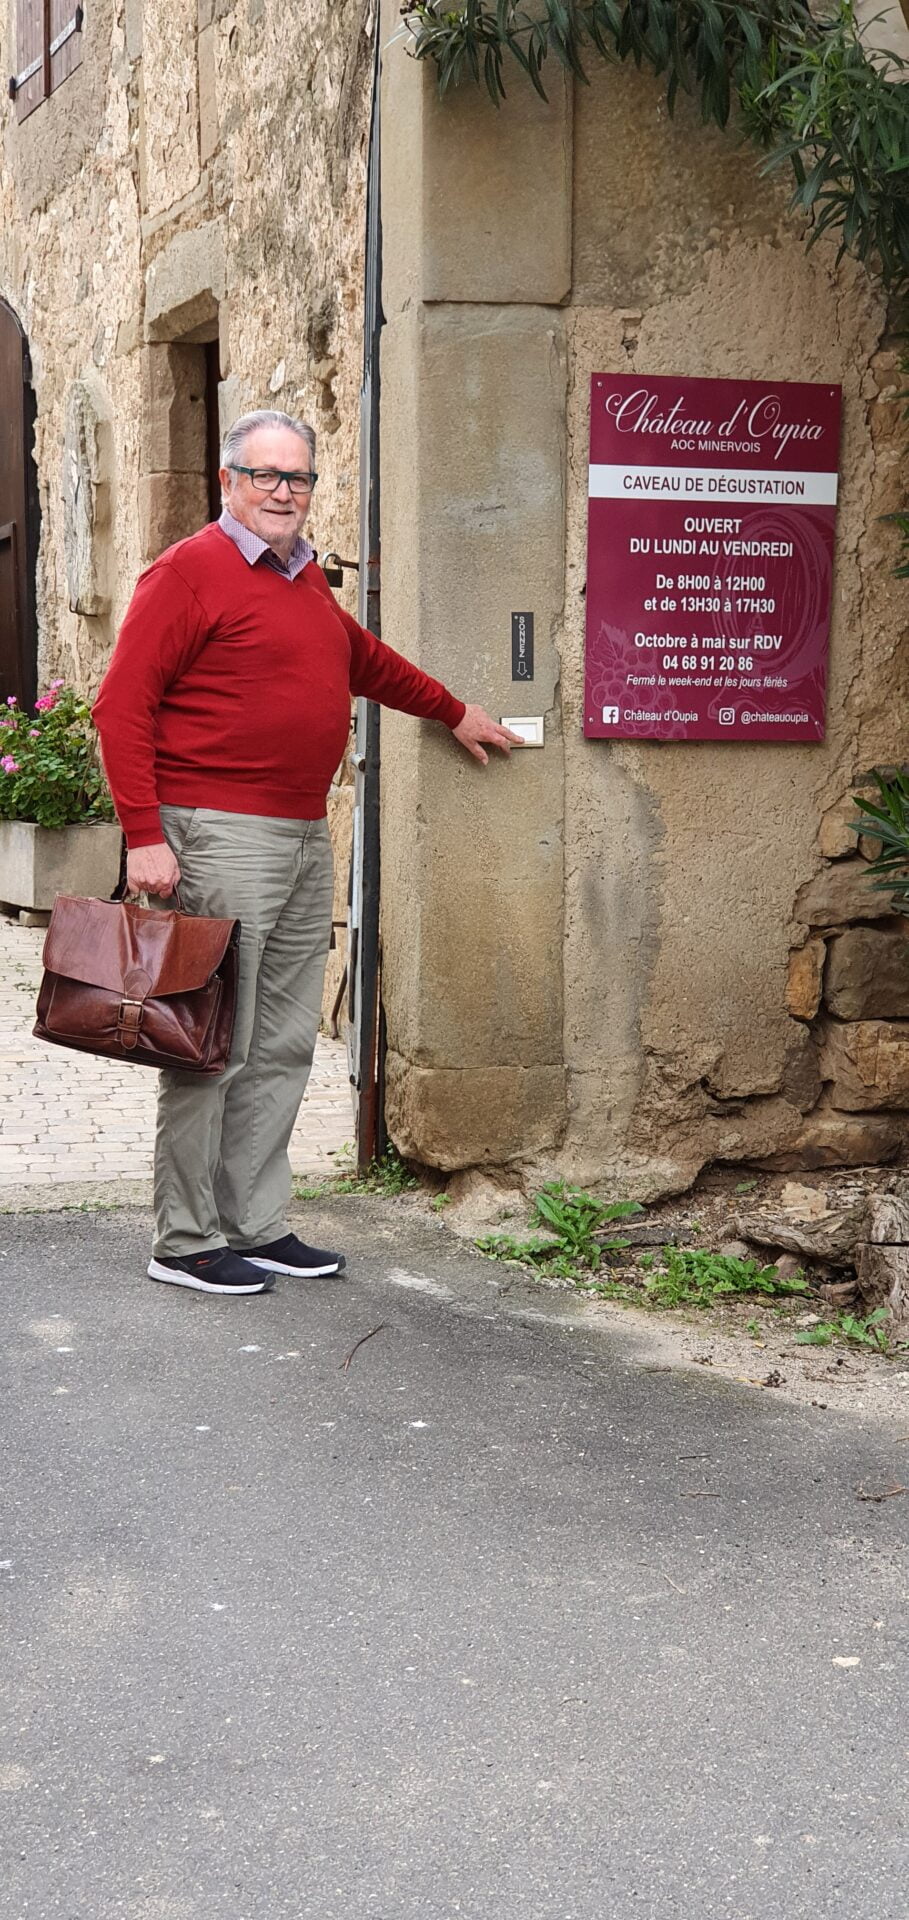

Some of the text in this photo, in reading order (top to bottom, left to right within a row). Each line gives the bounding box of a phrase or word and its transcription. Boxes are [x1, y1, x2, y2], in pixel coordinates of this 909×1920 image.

[605, 389, 825, 460] Château d'Oupia
[671, 439, 761, 453] AOC MINERVOIS
[623, 475, 805, 495] CAVEAU DE DÉGUSTATION
[684, 518, 742, 534] OUVERT
[630, 538, 793, 557] DU LUNDI AU VENDREDI
[656, 574, 765, 591] De 8H00 à 12H00
[644, 597, 775, 613] et de 13H30 à 17H30
[635, 633, 782, 650] Octobre à mai sur RDV
[663, 656, 753, 671] 04 68 91 20 86
[627, 674, 788, 689] Fermé le week-end et les jours fériés
[624, 709, 698, 724] Château d'Oupia
[741, 711, 809, 725] @chateauoupia
